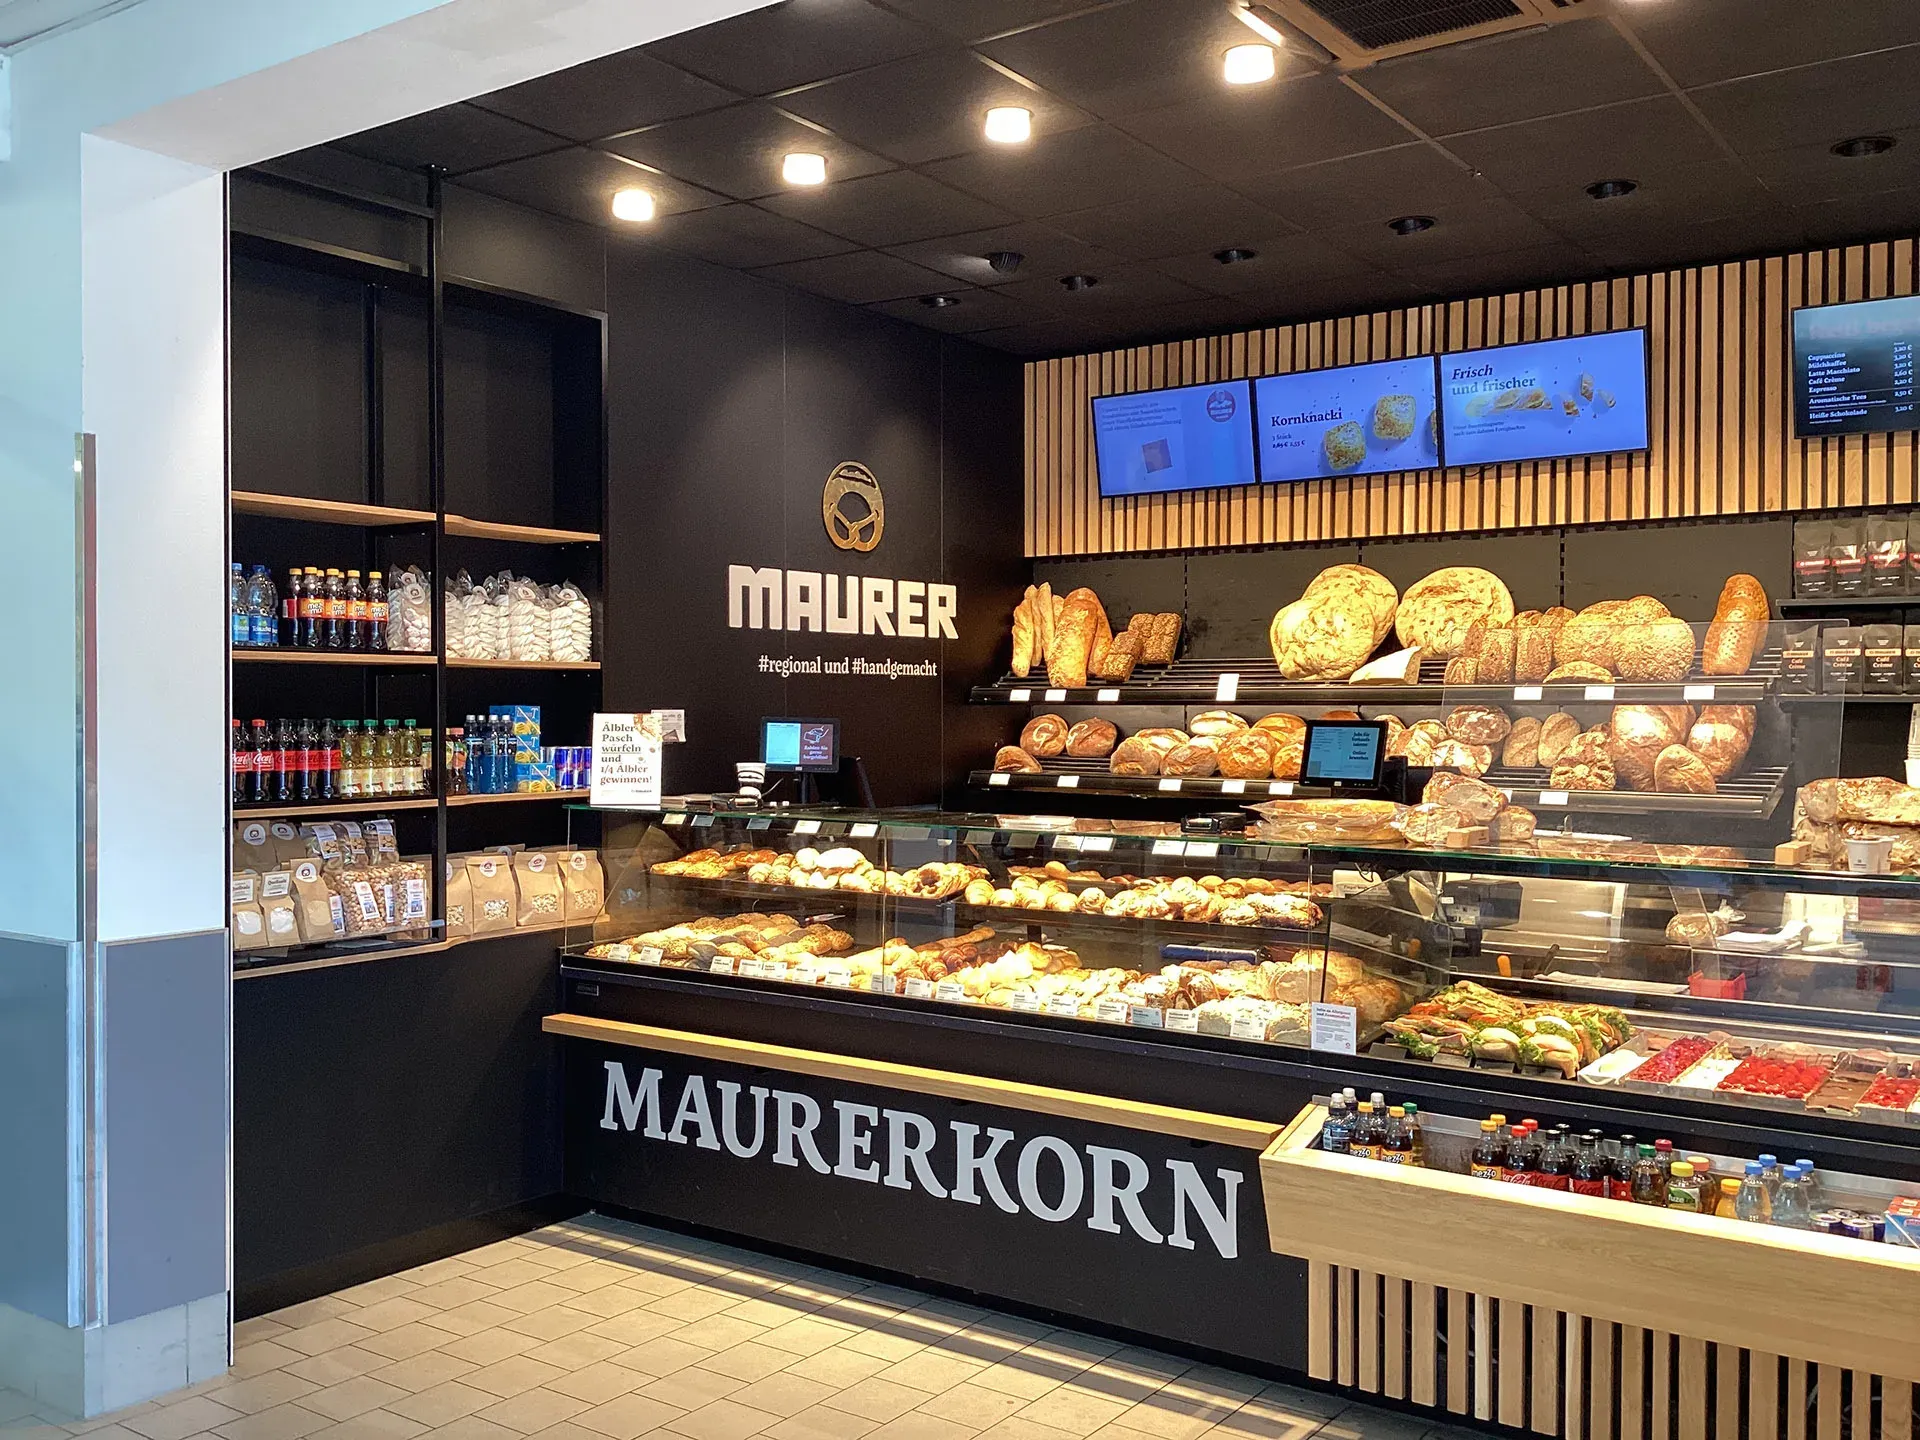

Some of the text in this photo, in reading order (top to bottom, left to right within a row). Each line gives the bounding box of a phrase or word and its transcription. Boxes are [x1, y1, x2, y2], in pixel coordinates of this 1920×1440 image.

[1808, 352, 1845, 361] Cappuccino
[1808, 360, 1846, 368] Milchkaffee
[1452, 365, 1493, 380] Frisch
[1826, 367, 1860, 375] Macchiato
[1452, 377, 1536, 395] und frischer
[1809, 386, 1837, 394] Espresso
[1809, 395, 1850, 404] Aromatische
[1271, 406, 1342, 427] Kornknacki
[1830, 408, 1867, 417] Schokolade
[729, 564, 959, 639] MAURER
[758, 655, 937, 679] #regional und #handgemacht
[602, 734, 633, 742] Pasch
[601, 744, 641, 752] würfeln
[600, 764, 613, 774] 1/4
[616, 763, 648, 773] Älbler
[600, 776, 652, 785] gewinnen!
[600, 1060, 1244, 1259] MAURERKORN
